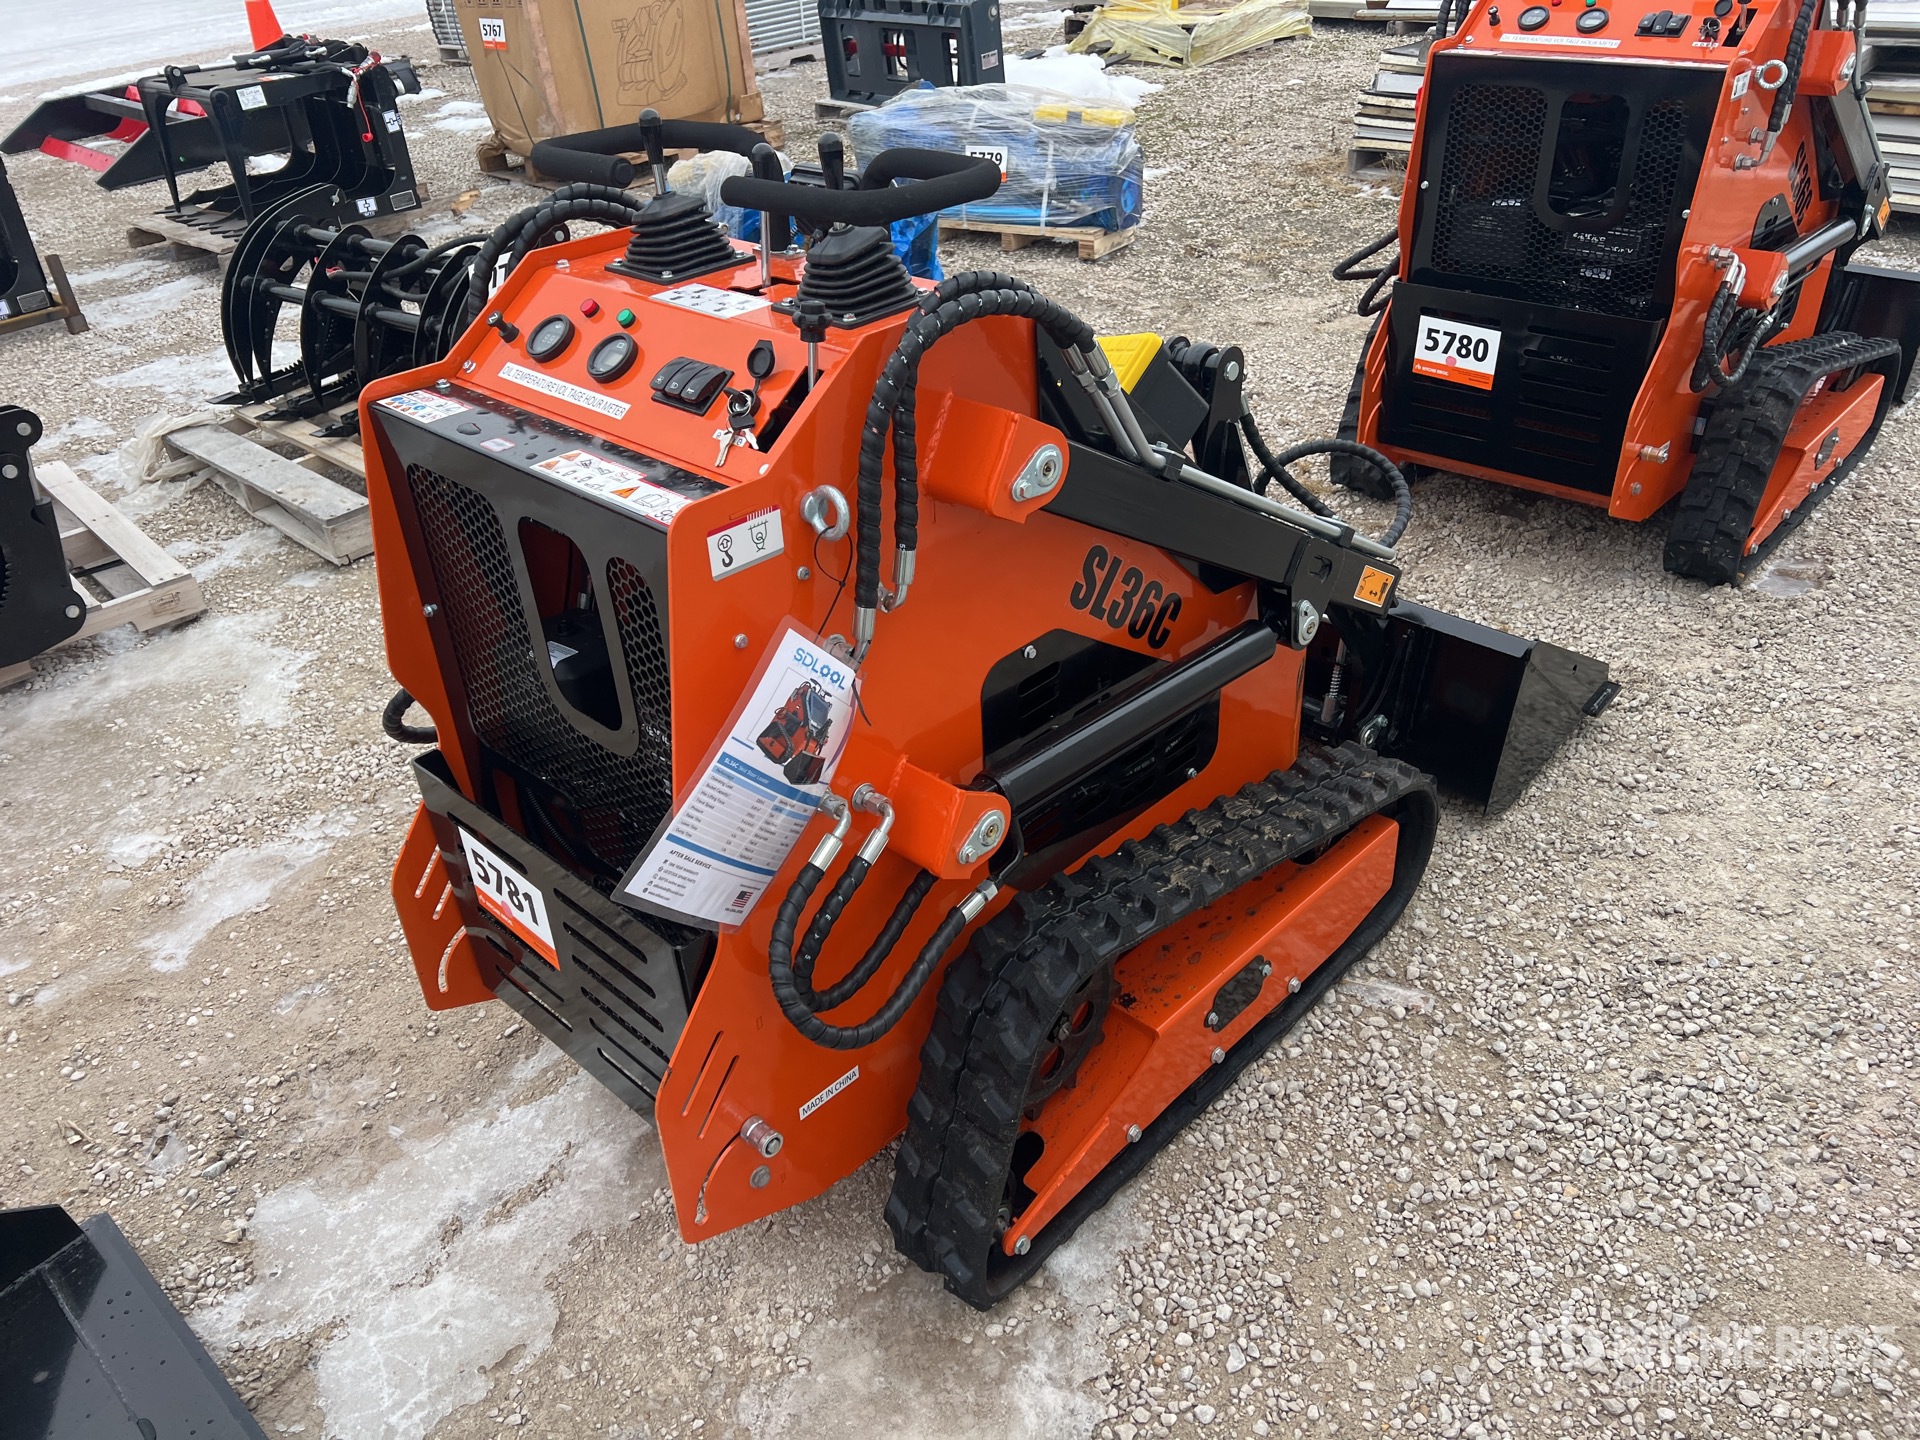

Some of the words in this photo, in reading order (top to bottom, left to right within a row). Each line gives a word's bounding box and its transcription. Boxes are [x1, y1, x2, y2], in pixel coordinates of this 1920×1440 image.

[482, 24, 501, 36] 5767
[1424, 328, 1489, 362] 5780
[513, 370, 556, 390] TEMPERATURE
[582, 393, 604, 408] HOUR
[601, 400, 626, 416] METER
[1070, 544, 1182, 650] SL36C
[470, 848, 538, 926] 5781
[802, 1094, 826, 1116] MADE
[826, 1087, 834, 1098] IN
[834, 1070, 856, 1091] CHINA
